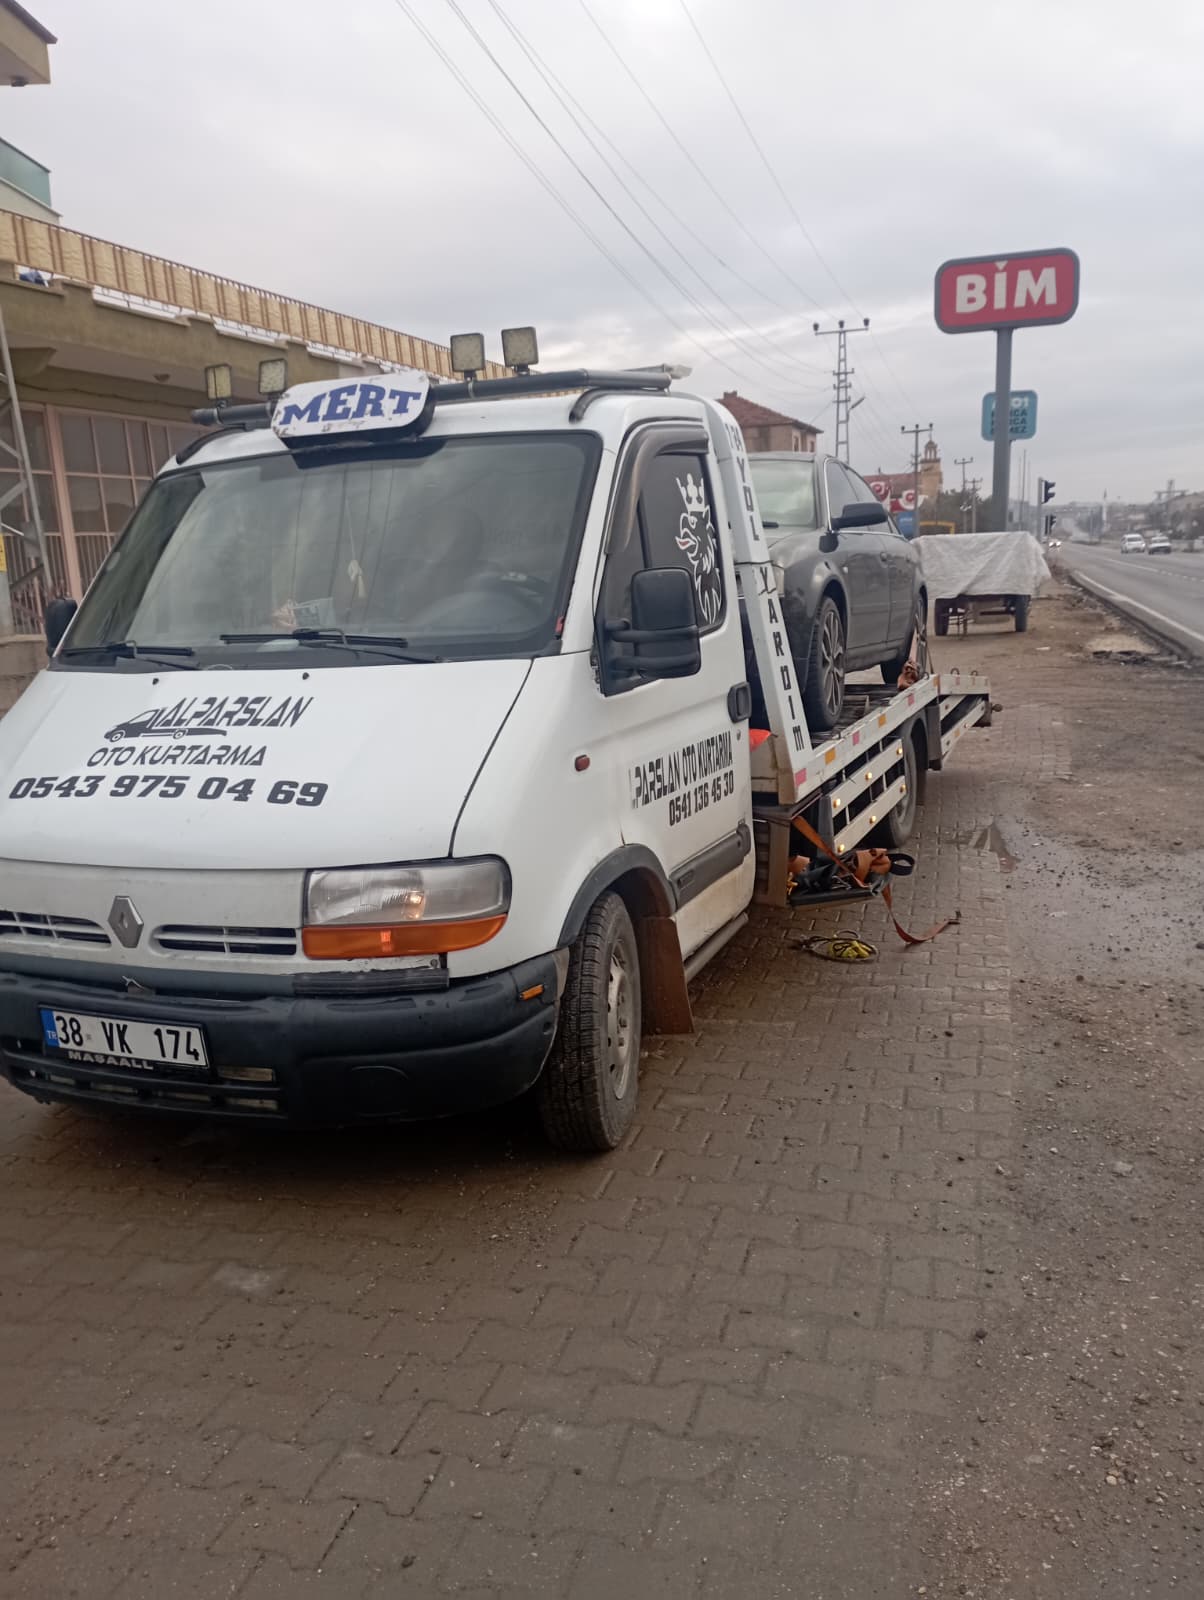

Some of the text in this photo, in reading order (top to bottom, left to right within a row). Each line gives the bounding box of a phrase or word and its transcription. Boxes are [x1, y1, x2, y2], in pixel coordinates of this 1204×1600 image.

[956, 261, 1057, 313] BİM
[279, 384, 421, 425] MERT
[155, 696, 314, 727] ALPARSLAN
[87, 745, 267, 767] OTO KURTARMA
[682, 744, 697, 786] OTO
[697, 731, 733, 779] KURTARMA
[9, 775, 328, 807] 0543 975 04 69
[669, 769, 734, 826] 0541 136 45 30
[56, 1015, 83, 1047] 38
[101, 1020, 133, 1054] VK
[154, 1027, 200, 1060] 174
